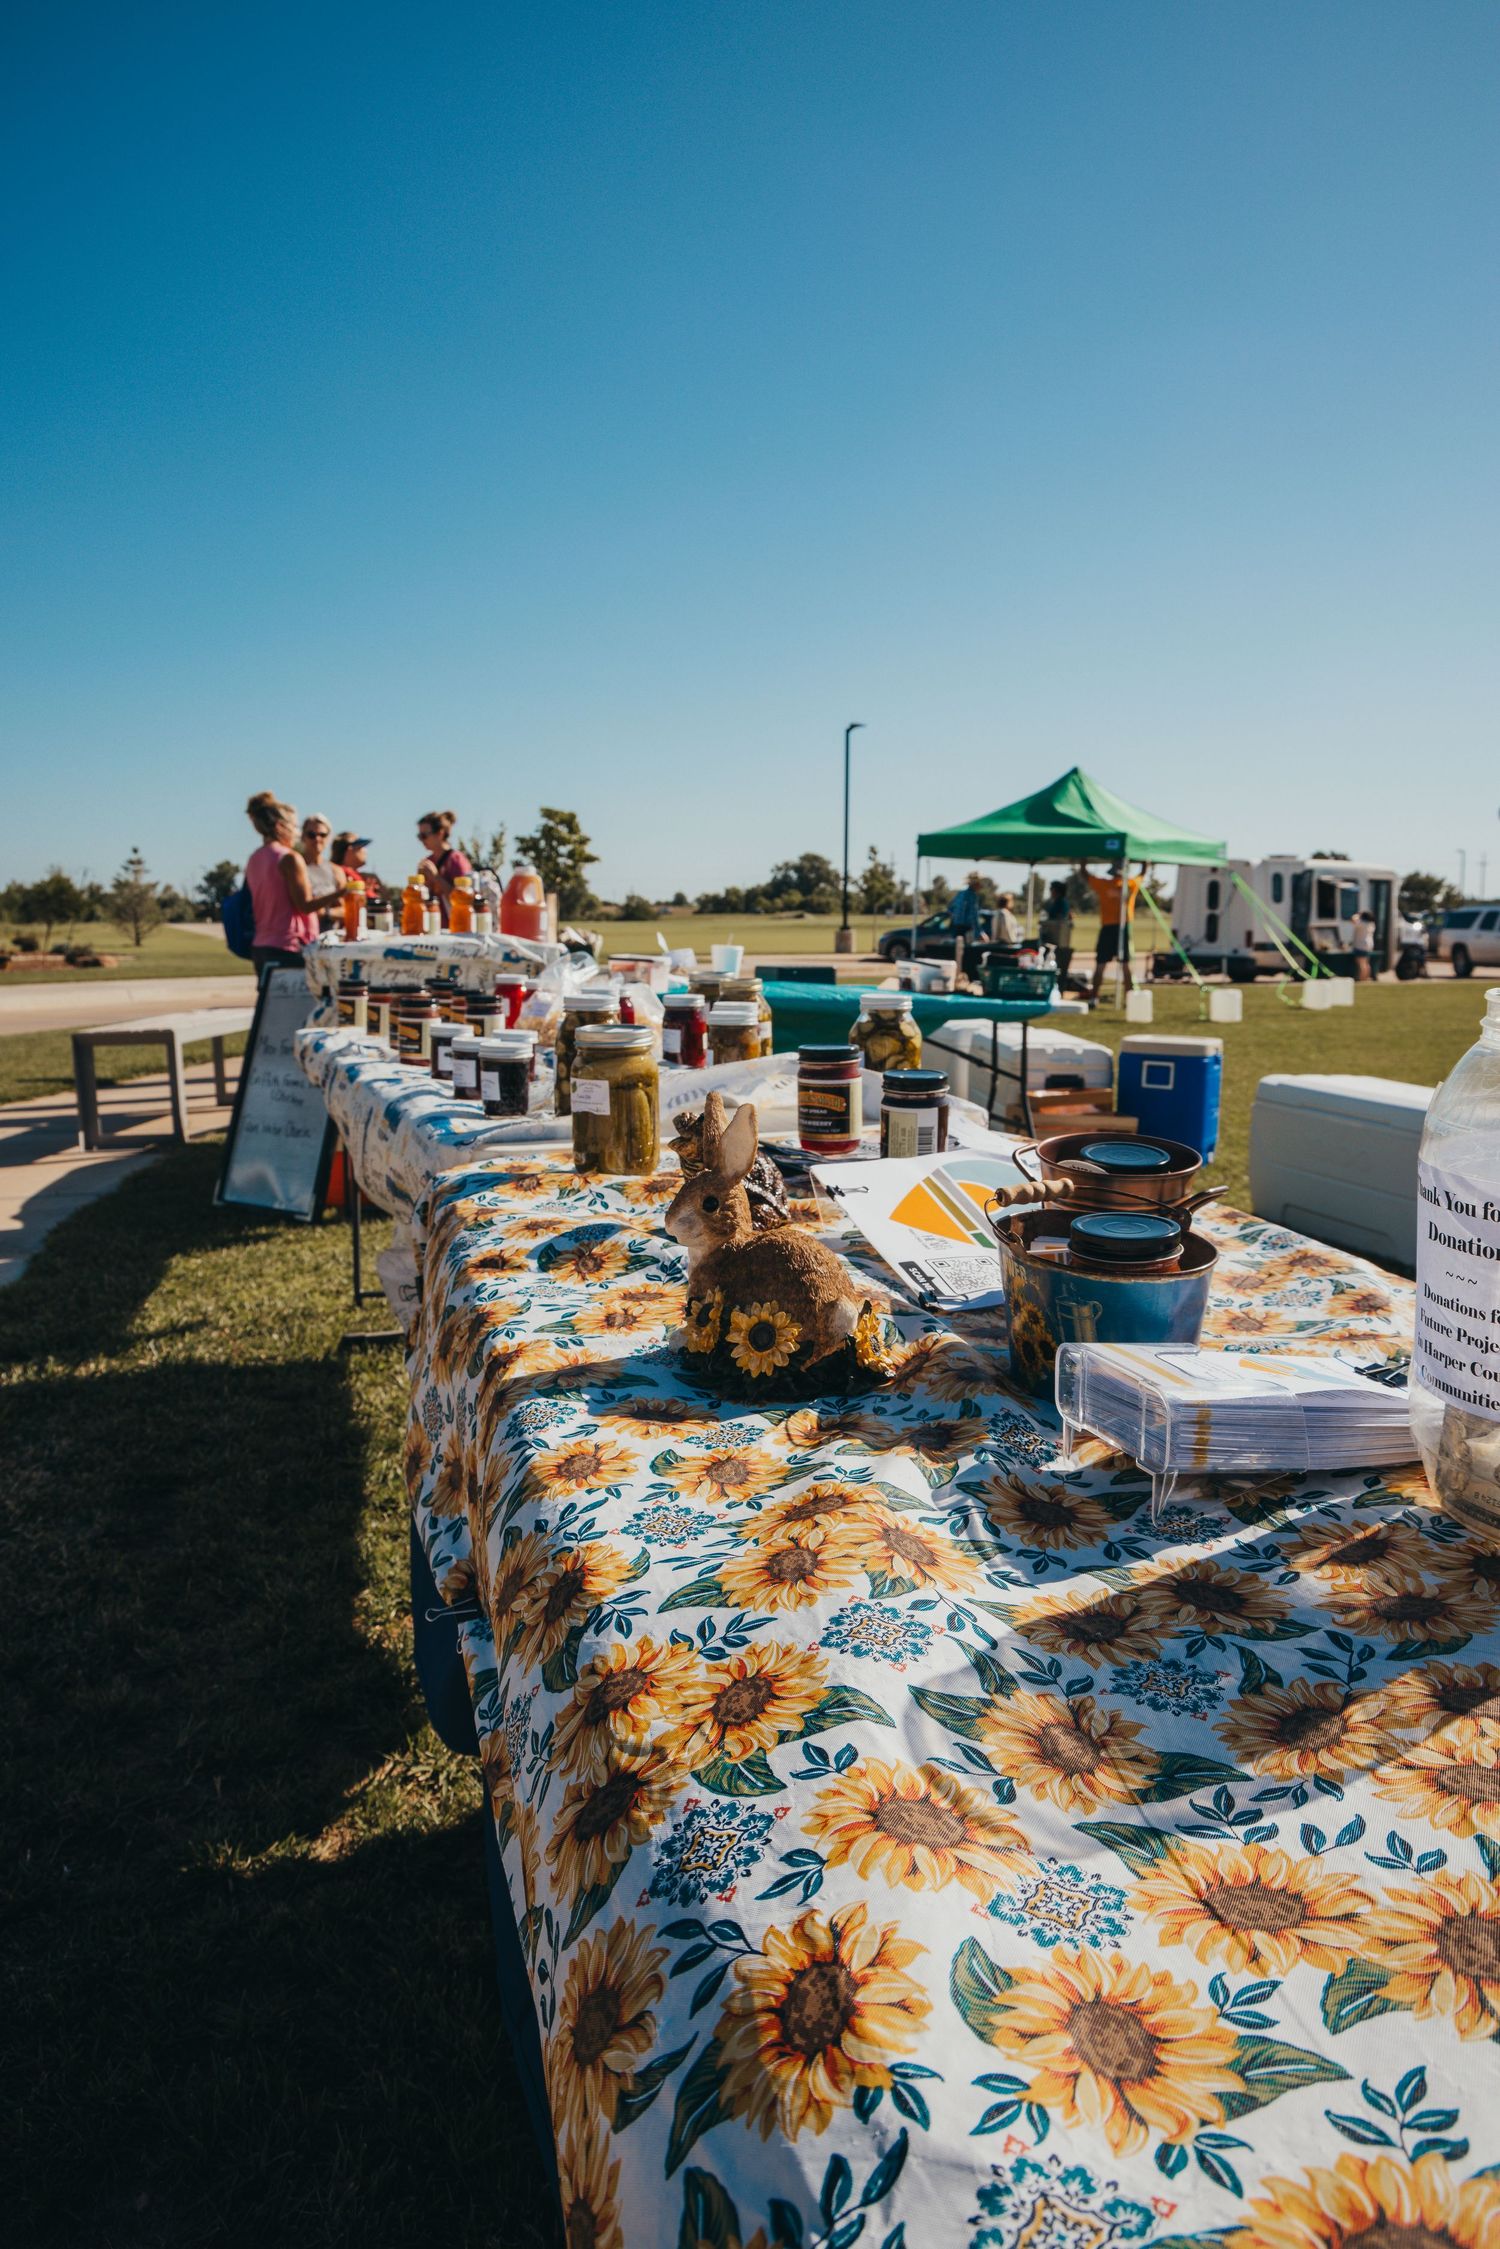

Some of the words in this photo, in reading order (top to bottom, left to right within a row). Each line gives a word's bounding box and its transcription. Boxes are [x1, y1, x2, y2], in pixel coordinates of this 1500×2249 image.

[1444, 1191, 1477, 1218] You
[909, 1267, 927, 1283] SCAN
[1424, 1283, 1486, 1321] Donations
[1420, 1308, 1453, 1338] Future
[1424, 1339, 1466, 1371] Harper
